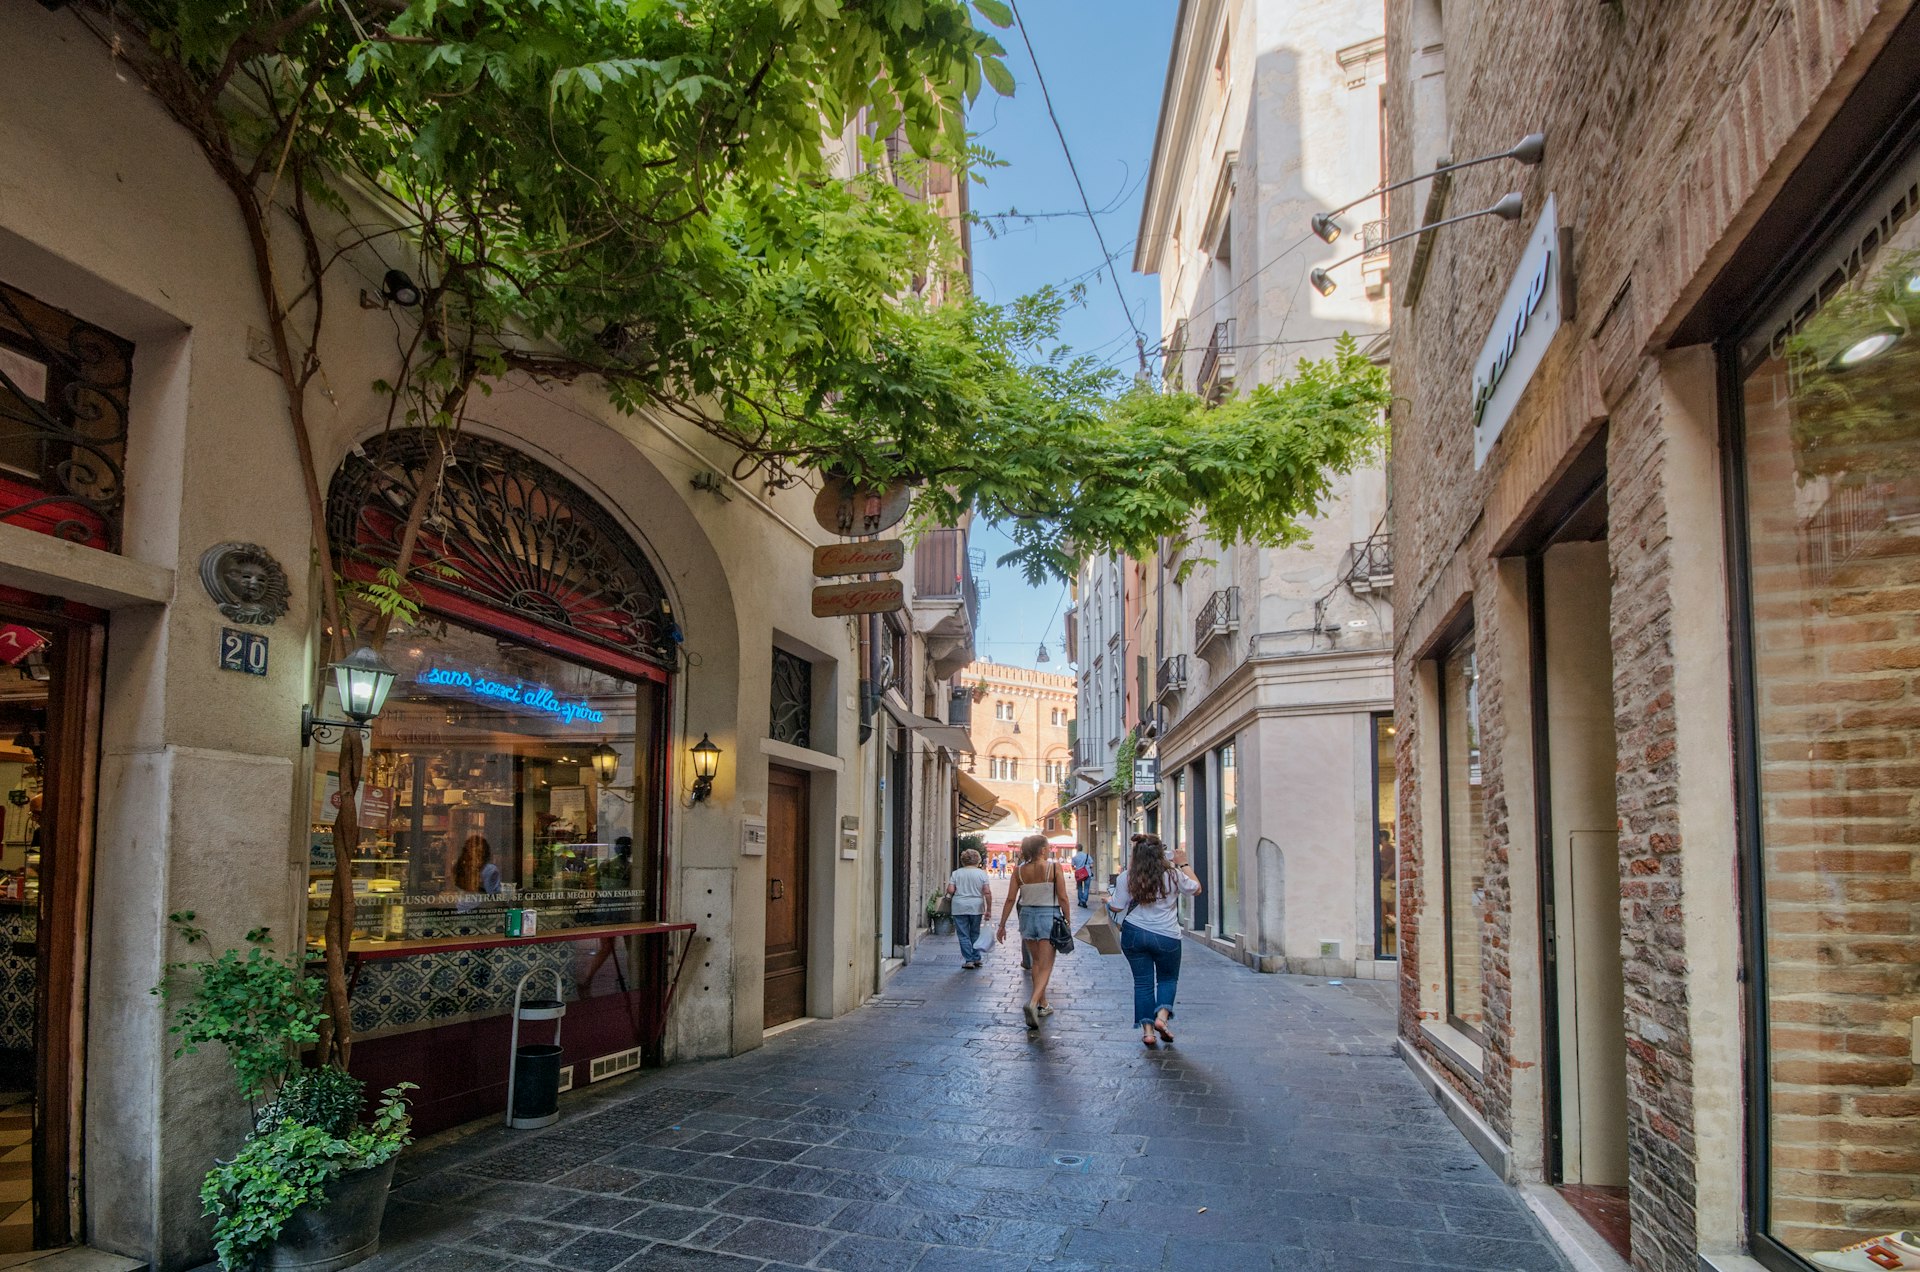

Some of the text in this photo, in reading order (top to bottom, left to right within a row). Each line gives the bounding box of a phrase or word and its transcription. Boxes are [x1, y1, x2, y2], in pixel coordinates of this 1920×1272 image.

[820, 549, 894, 567] Osteria
[225, 636, 266, 668] 20
[428, 667, 473, 687] sans
[524, 688, 562, 712] alla
[399, 894, 435, 905] LUSSO
[438, 893, 463, 904] NON
[512, 891, 523, 901] SE
[524, 891, 556, 901] CERCHI
[567, 890, 596, 900] MEGLIO
[597, 889, 614, 898] NON
